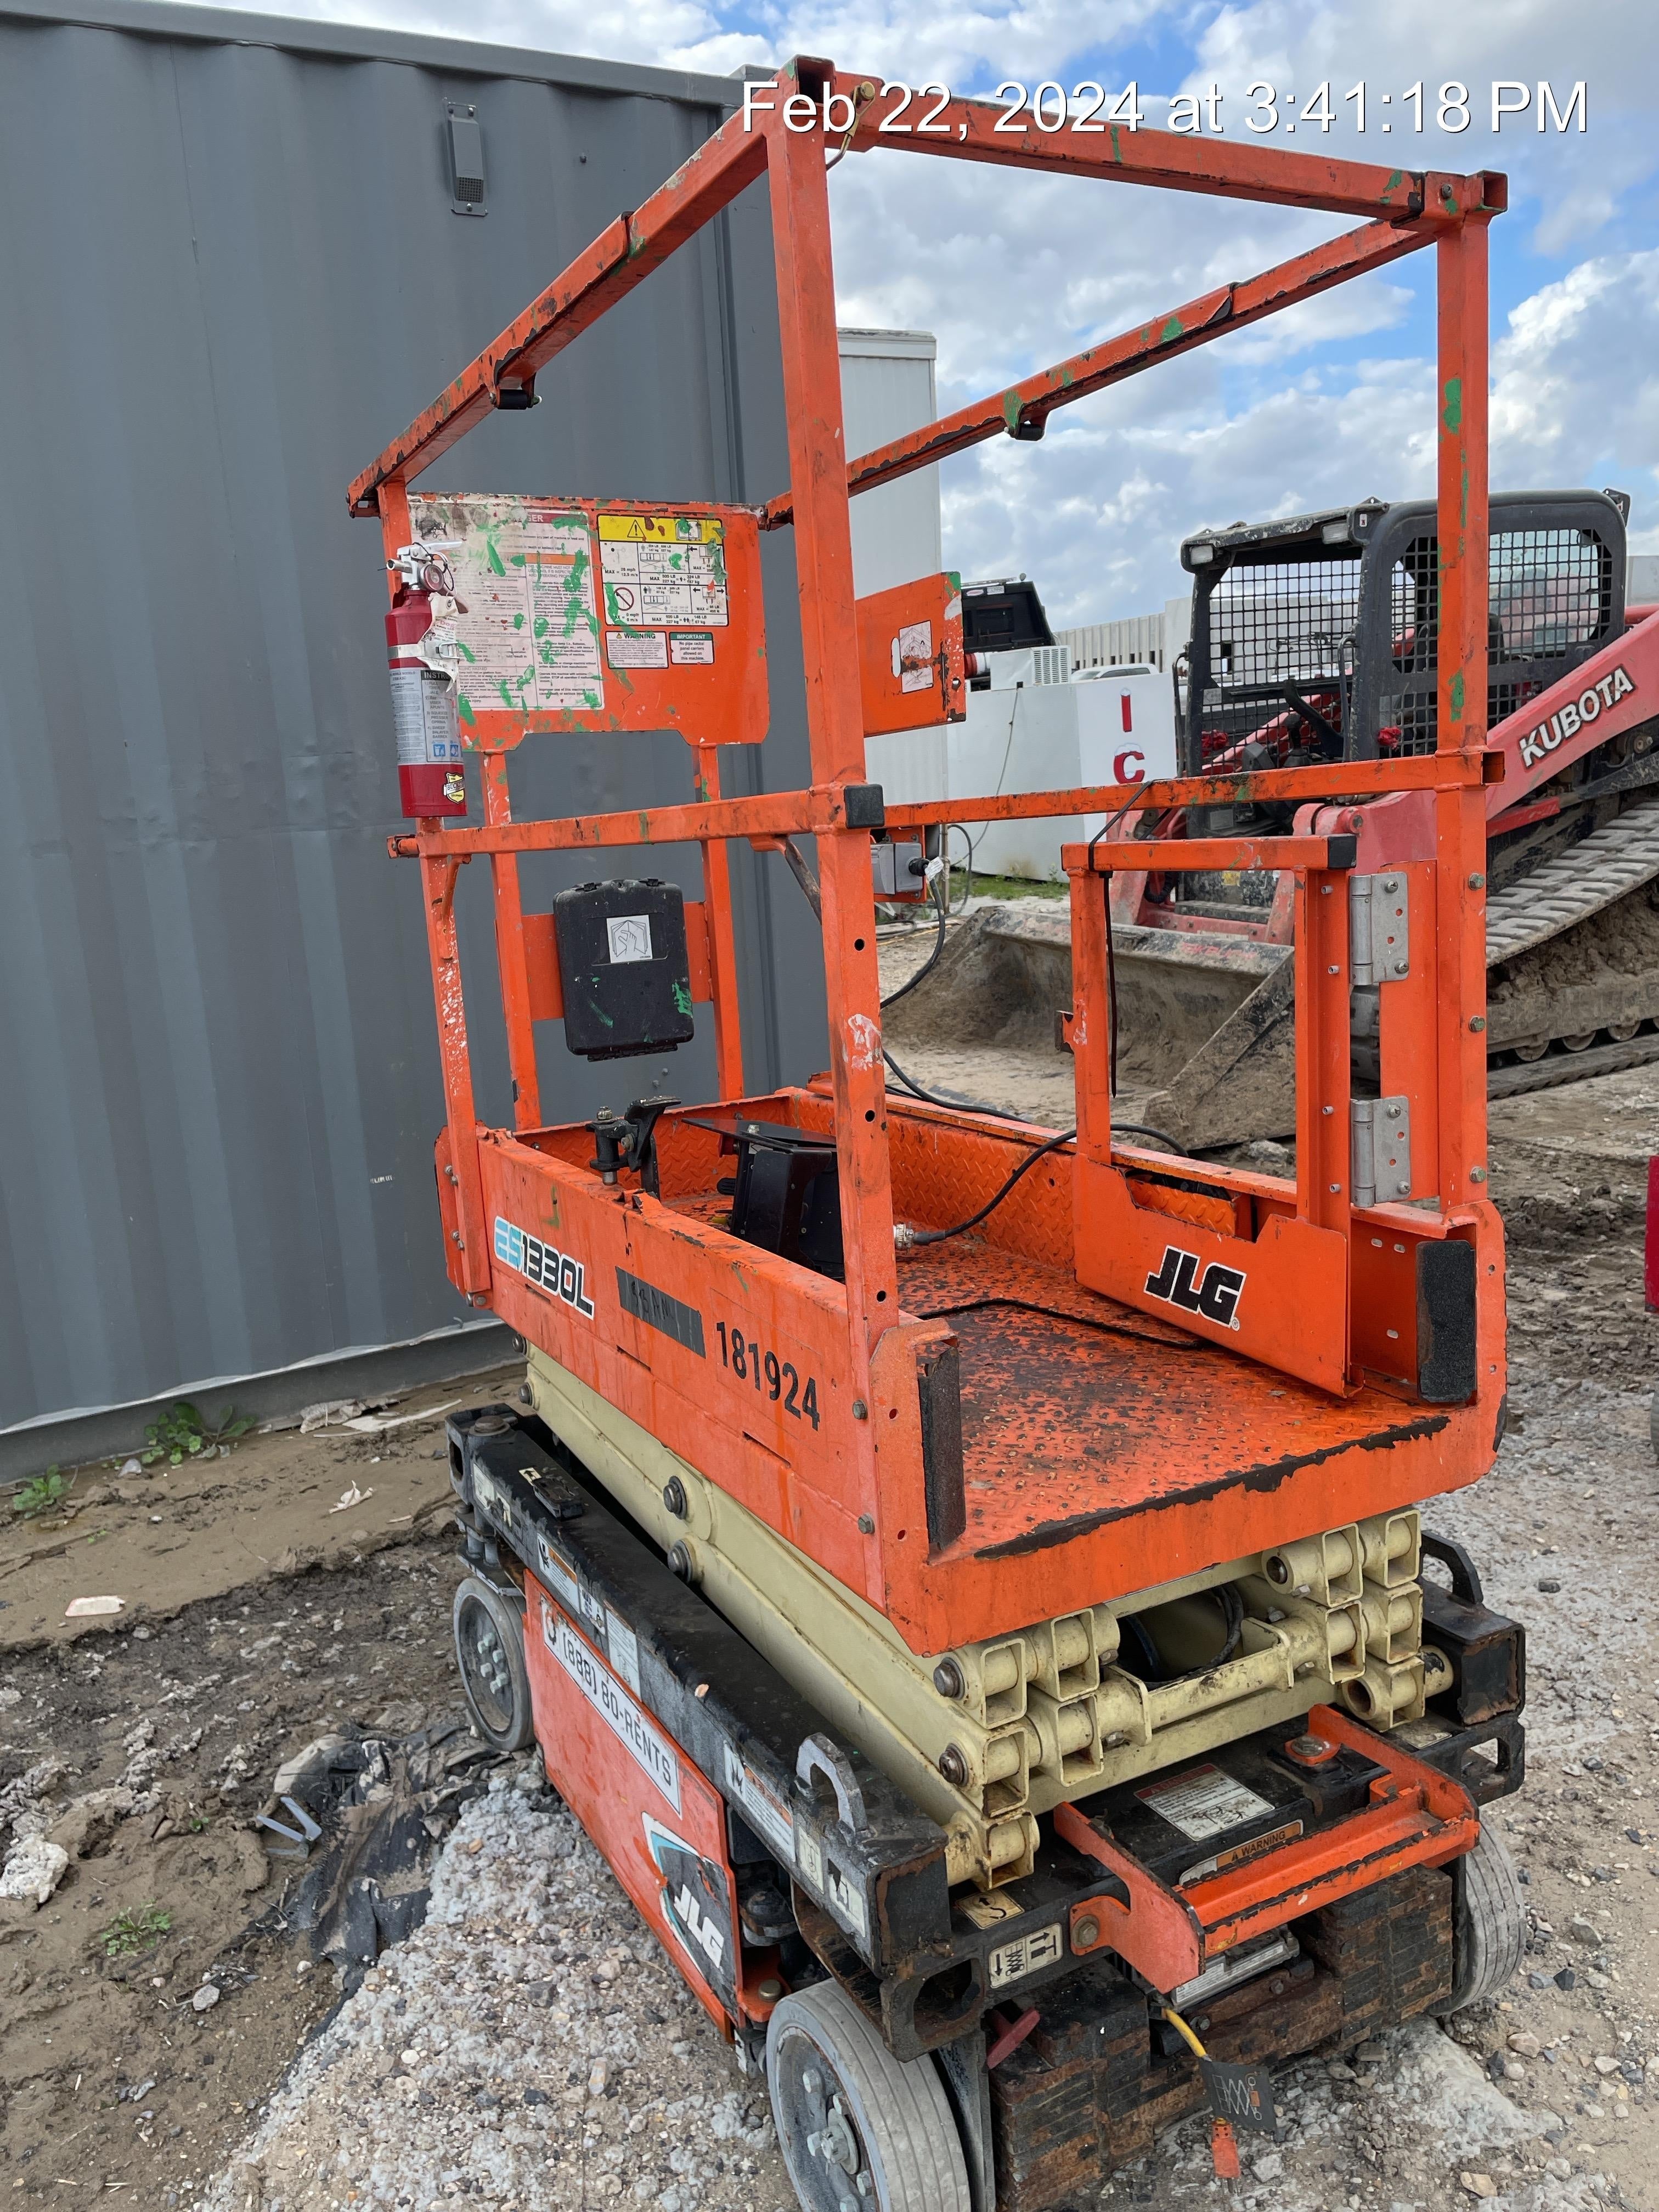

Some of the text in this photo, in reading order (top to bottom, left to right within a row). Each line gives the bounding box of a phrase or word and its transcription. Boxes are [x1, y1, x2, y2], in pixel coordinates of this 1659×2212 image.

[1519, 667, 1635, 768] KUBOTA
[494, 1216, 595, 1321] ES1330L
[1143, 1245, 1248, 1329] JLG
[716, 1321, 820, 1432] 181924
[562, 1632, 597, 1696] (888)
[1240, 1831, 1286, 1857] WARNING
[673, 1883, 725, 1969] JLG
